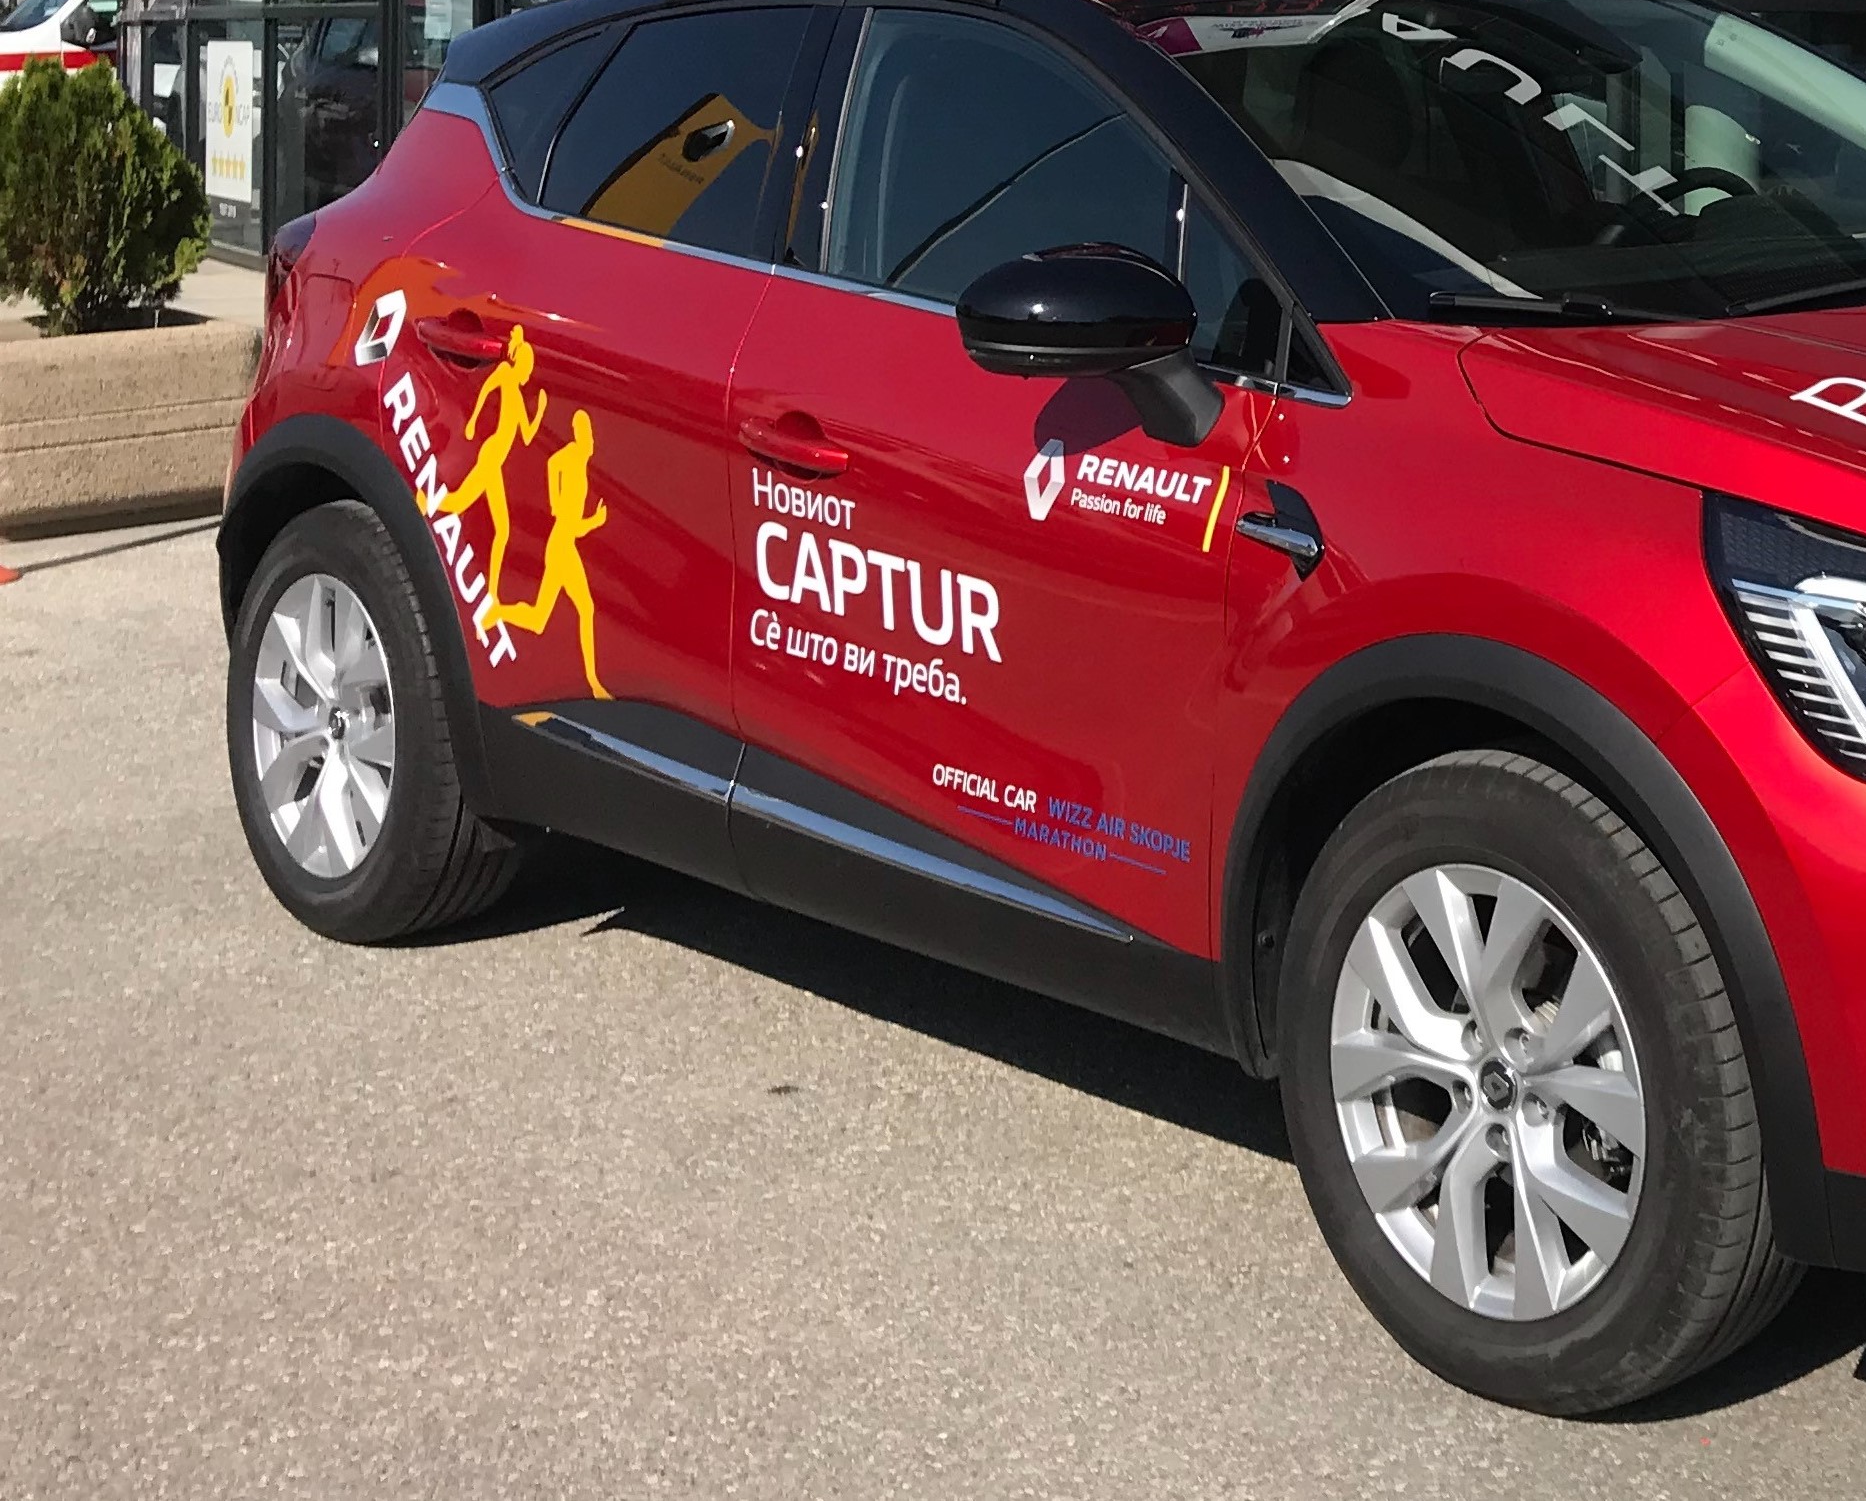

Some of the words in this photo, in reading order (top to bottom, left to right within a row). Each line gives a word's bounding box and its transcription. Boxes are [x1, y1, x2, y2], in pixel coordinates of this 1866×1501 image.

[752, 468, 856, 530] Новиот
[1071, 487, 1120, 516] Passion
[1122, 498, 1144, 519] for
[1144, 502, 1167, 525] life
[1076, 454, 1212, 504] RENAULT
[383, 371, 517, 669] RENAULT
[756, 520, 1002, 663] CAPTUR
[786, 631, 838, 666] што
[844, 644, 876, 678] ви
[882, 652, 967, 705] треба.
[932, 763, 999, 803] OFFICIAL
[1004, 785, 1037, 813] CAR
[1048, 796, 1092, 829] WIZZ
[1096, 813, 1126, 840] AIR
[1129, 822, 1191, 863] SKOPJE
[1014, 818, 1107, 861] MARATHON
